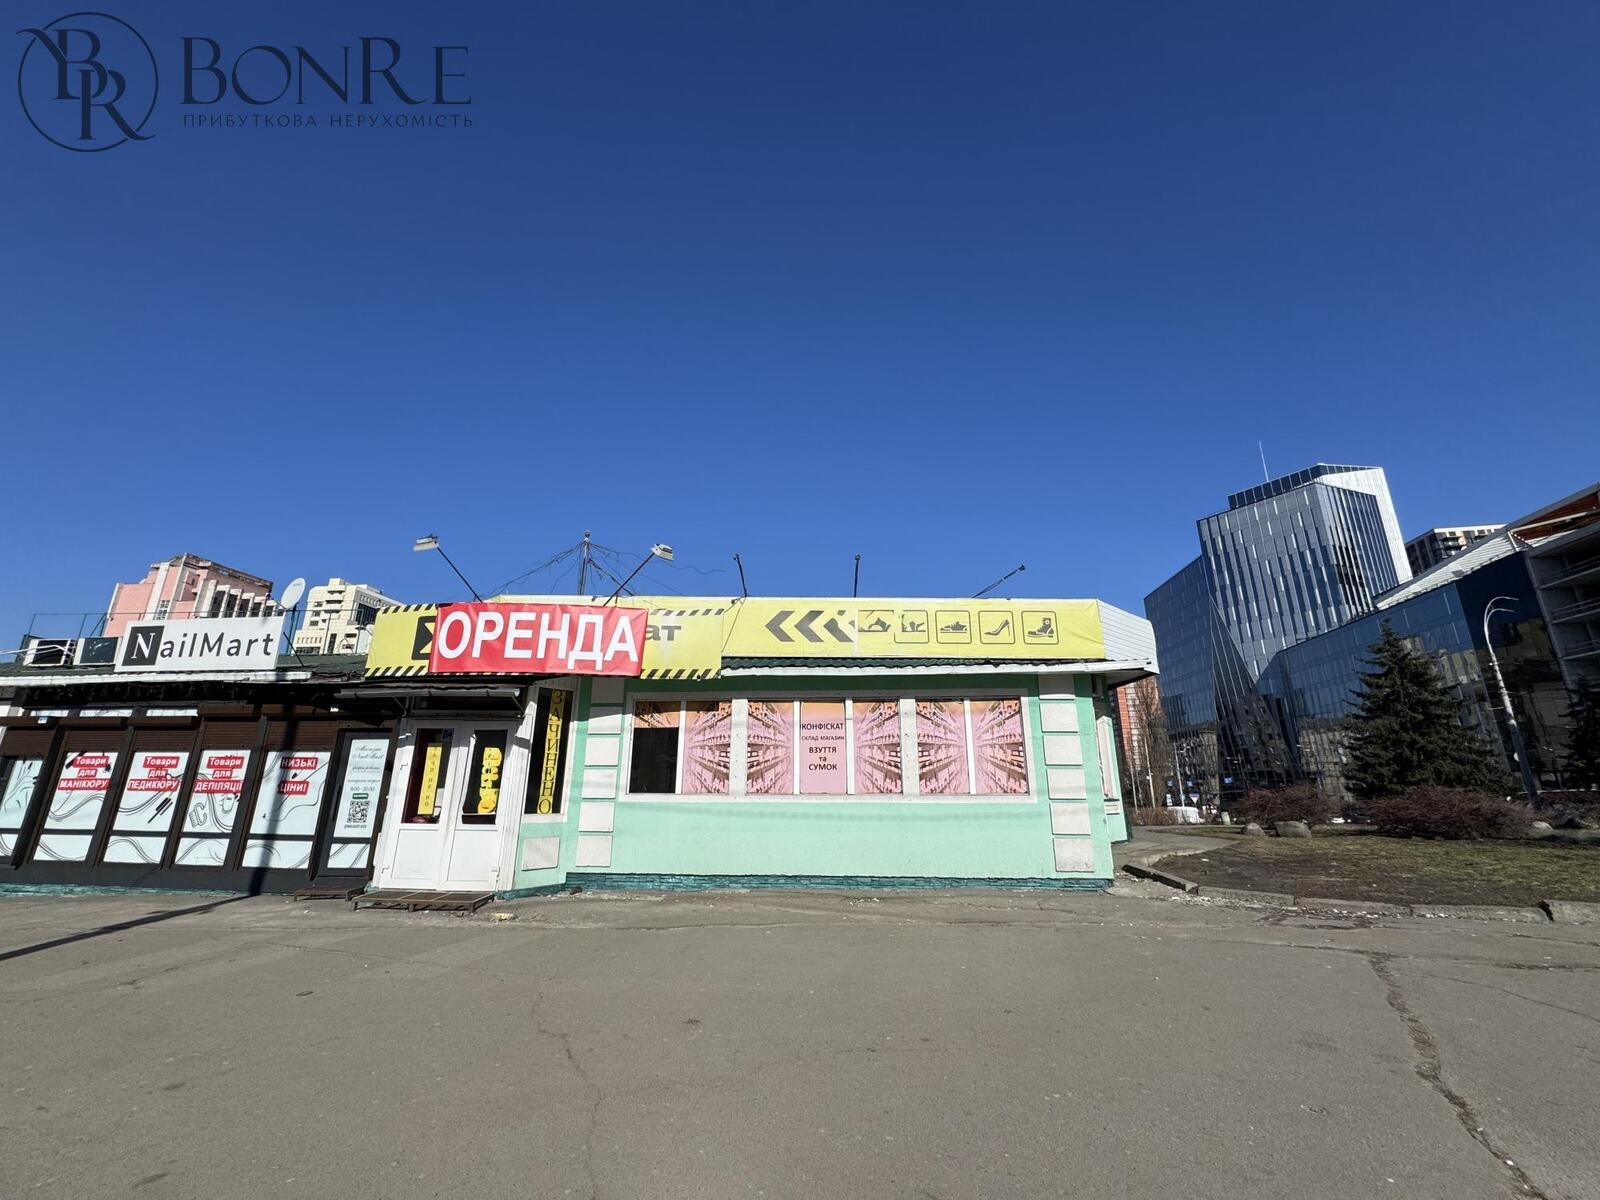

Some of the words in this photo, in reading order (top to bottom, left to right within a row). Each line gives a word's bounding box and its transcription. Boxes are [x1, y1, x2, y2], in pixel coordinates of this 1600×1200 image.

[131, 632, 274, 660] NailMart
[438, 611, 639, 671] ОРЕНДА
[801, 722, 844, 731] КОНФІСКАТ
[808, 746, 837, 754] ВЗУТТЯ
[76, 756, 107, 766] Товари
[145, 757, 177, 767] Товари
[209, 757, 242, 767] Товари
[281, 758, 317, 768] НИЗЬКІ
[808, 763, 838, 771] СУМОК
[78, 769, 96, 777] для
[149, 769, 167, 778] для
[213, 769, 232, 778] для
[59, 779, 109, 789] МАНІКЮРУ
[127, 780, 179, 790] ПЕДИКЮРУ
